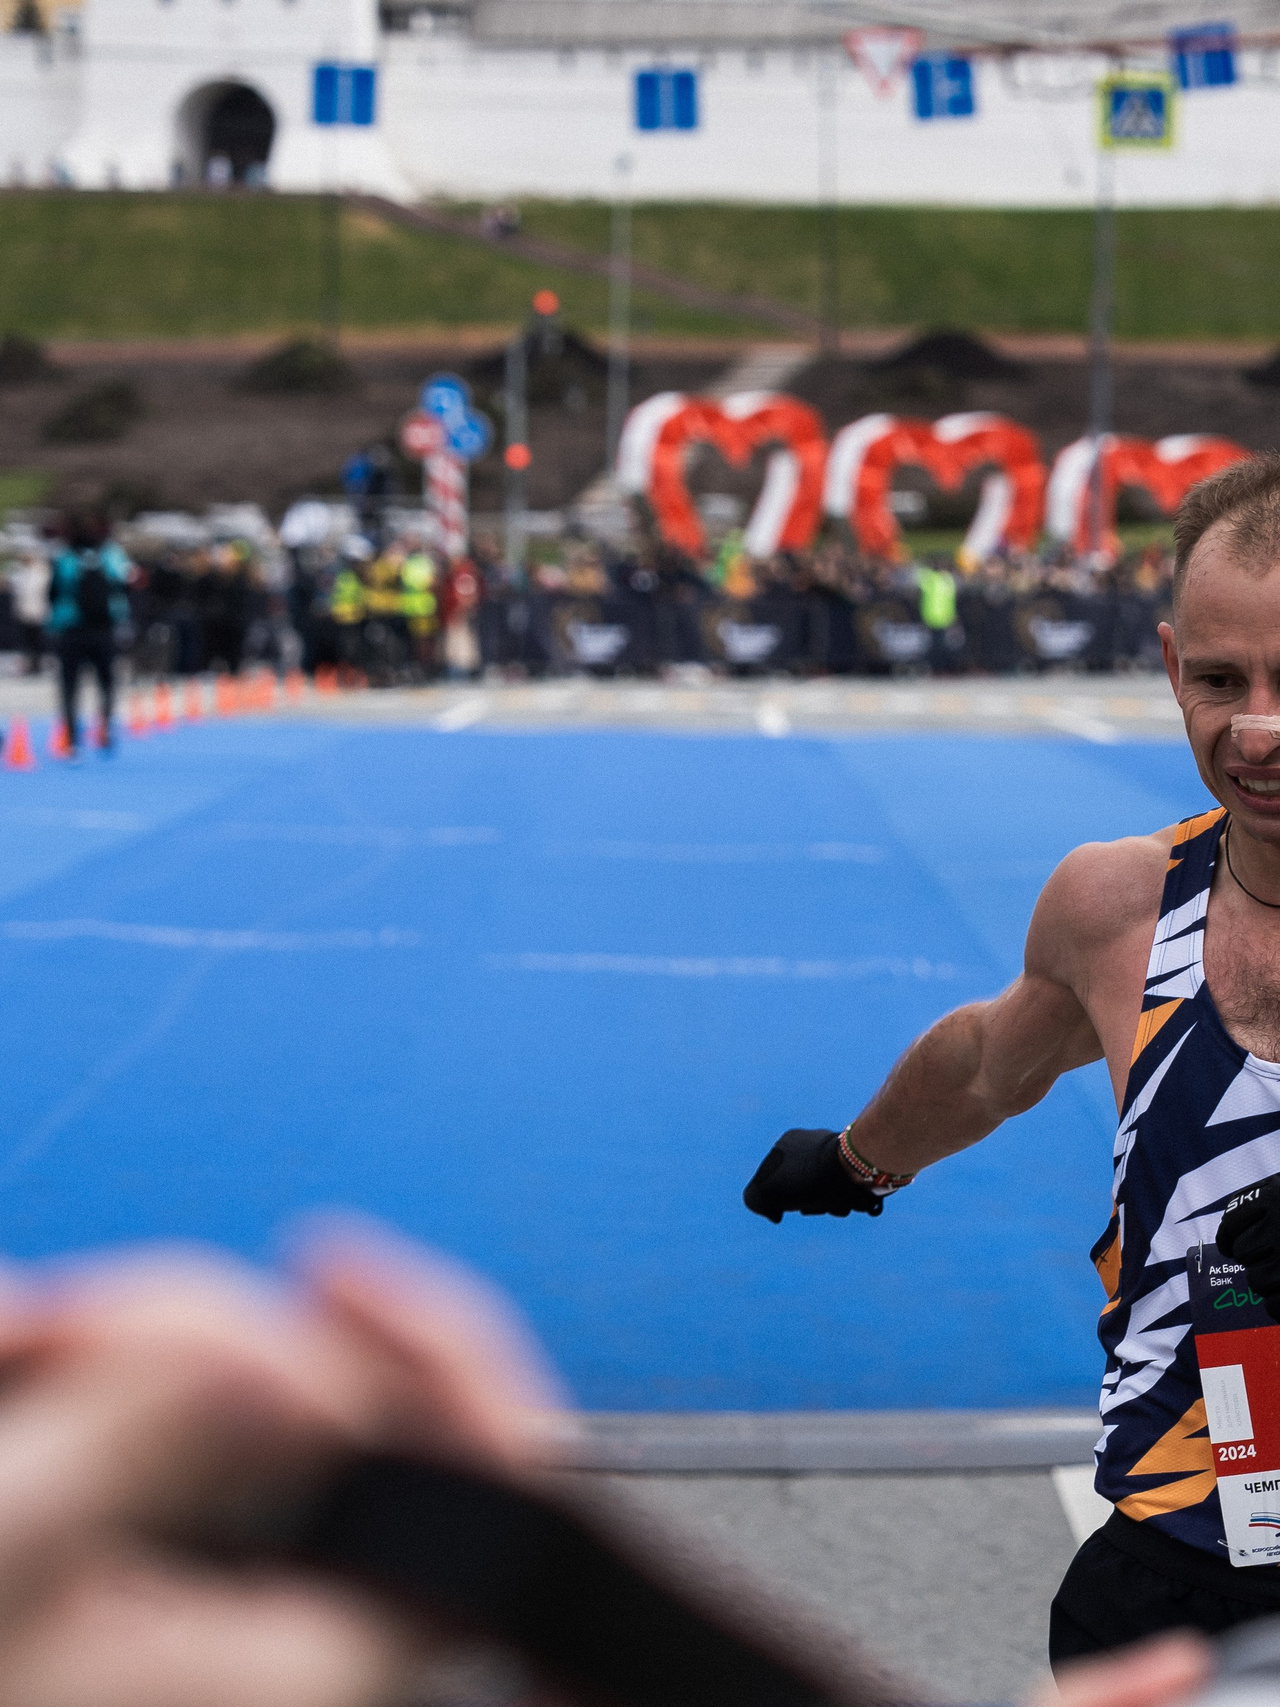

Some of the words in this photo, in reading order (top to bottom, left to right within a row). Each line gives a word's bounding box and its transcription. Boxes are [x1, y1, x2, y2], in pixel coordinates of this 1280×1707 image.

[1226, 1188, 1260, 1213] SKI
[1209, 1265, 1221, 1275] Ак
[1210, 1277, 1233, 1287] Банк
[1218, 1444, 1257, 1462] 2024
